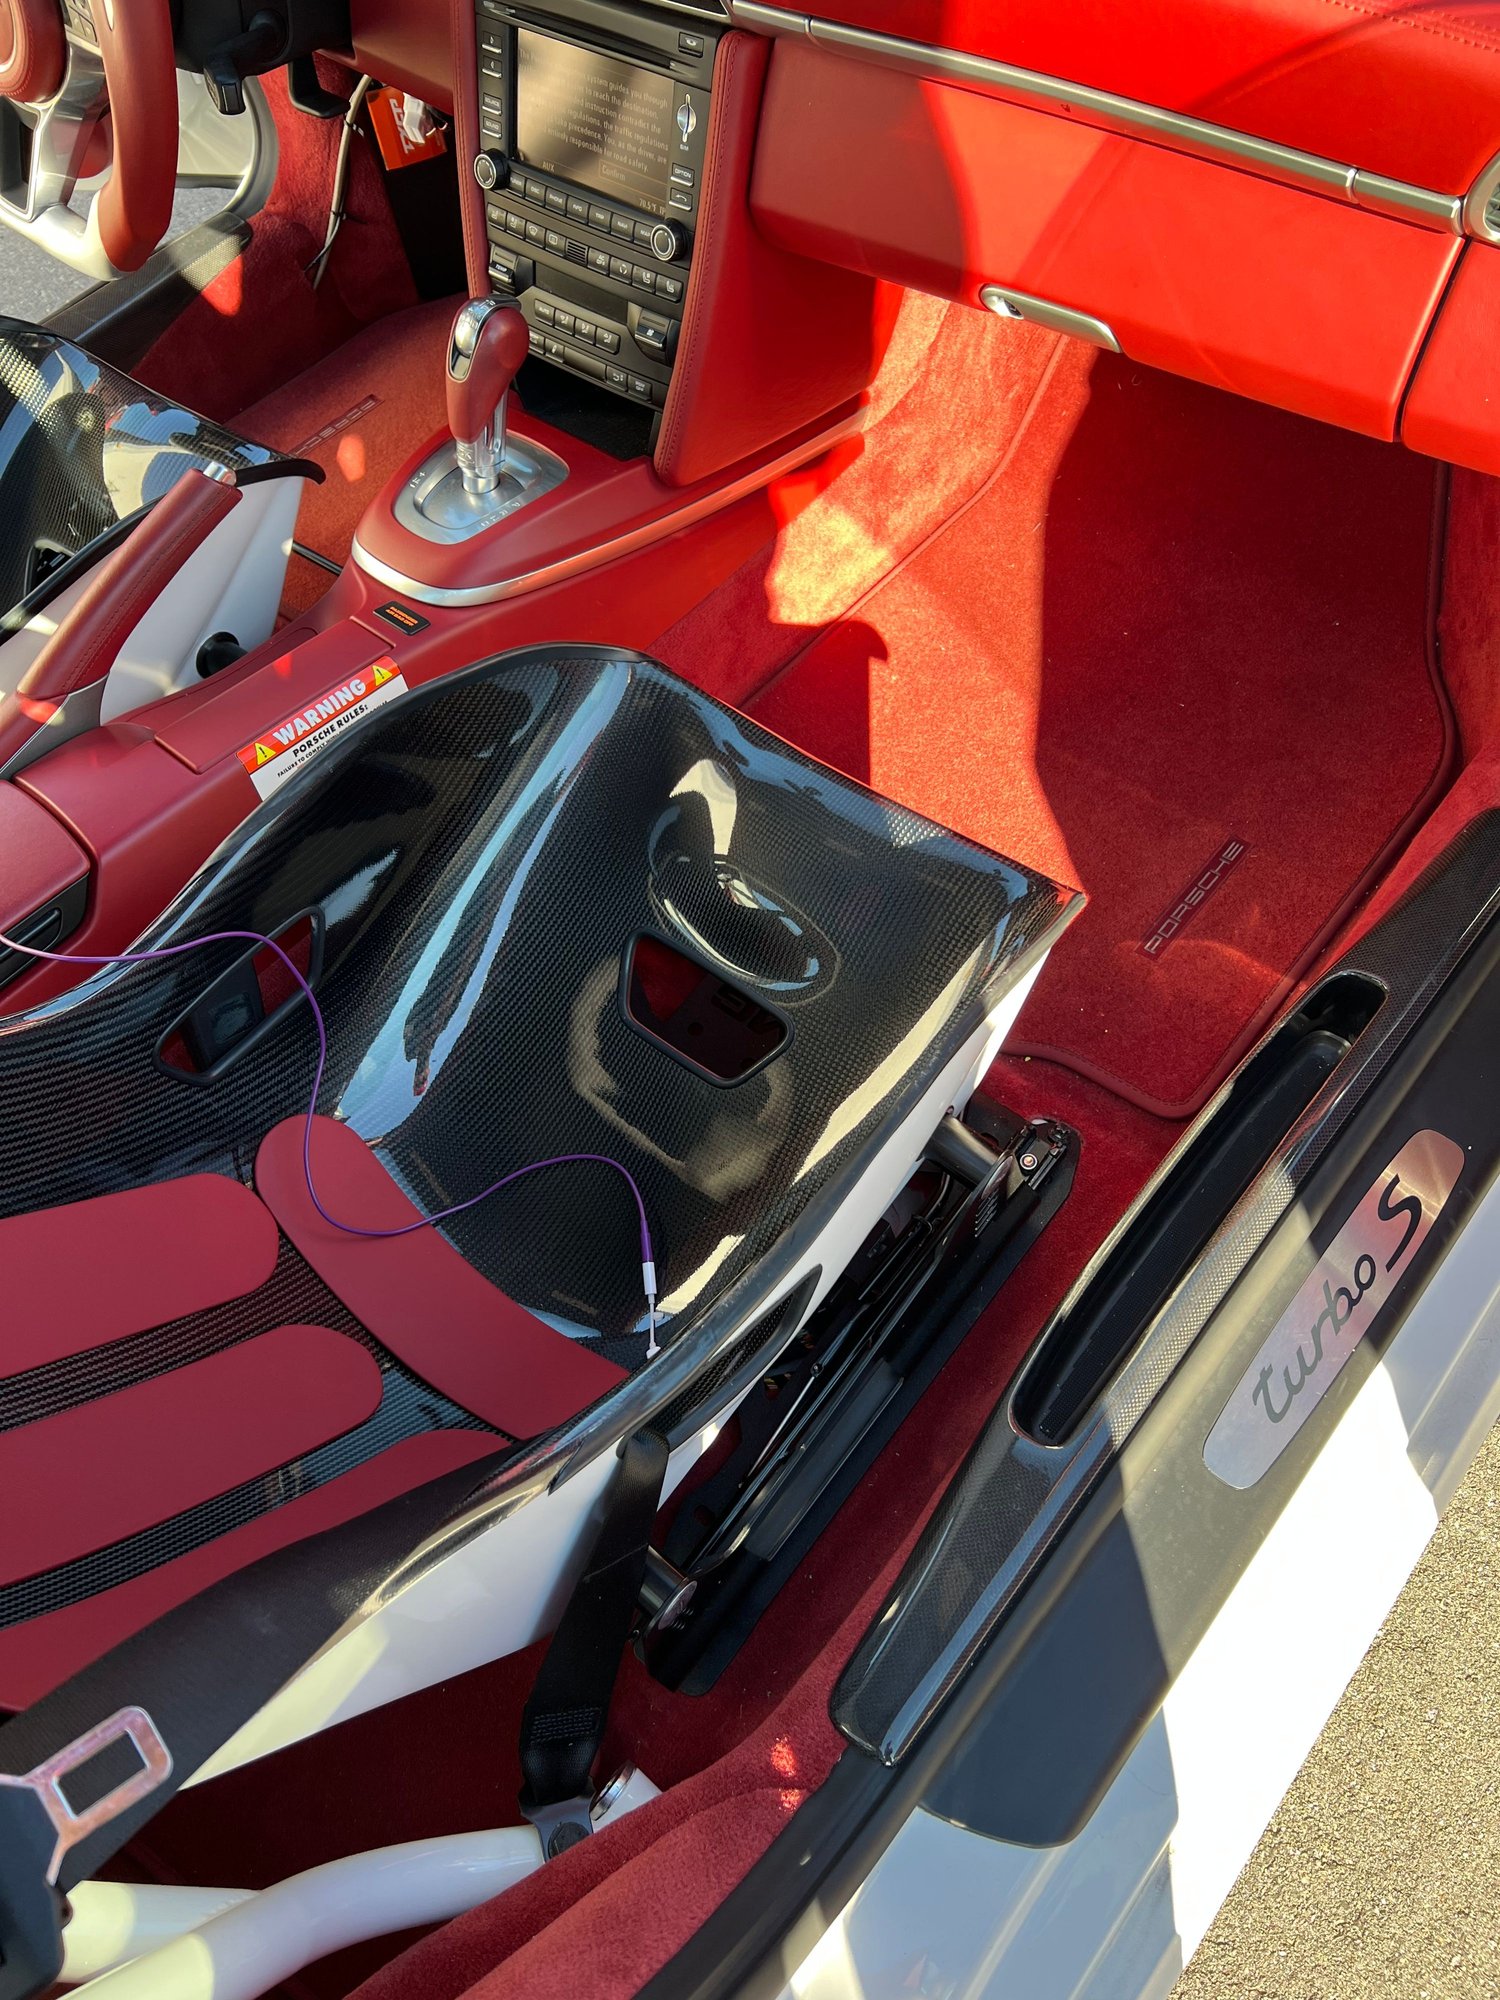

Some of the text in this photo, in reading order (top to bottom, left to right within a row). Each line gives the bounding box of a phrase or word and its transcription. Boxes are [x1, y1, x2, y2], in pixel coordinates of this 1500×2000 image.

[592, 88, 610, 102] reach
[610, 94, 621, 106] the
[608, 80, 629, 95] guides
[630, 88, 641, 100] you
[642, 91, 668, 109] through
[584, 98, 617, 119] instruction
[618, 111, 649, 131] contradict
[650, 123, 661, 135] the
[569, 134, 602, 154] responsible
[603, 146, 612, 158] for
[613, 150, 627, 164] road
[603, 120, 613, 131] the
[614, 124, 633, 139] traffic
[633, 132, 669, 152] regulations
[542, 161, 555, 172] AUX
[626, 142, 636, 154] the
[656, 155, 667, 165] are
[601, 163, 626, 180] Confirm
[272, 678, 367, 746] WARNING
[292, 725, 337, 758] PORSCHE
[337, 704, 369, 729] RULES:
[1143, 841, 1245, 954] PORSCHE
[1377, 1173, 1423, 1274] S
